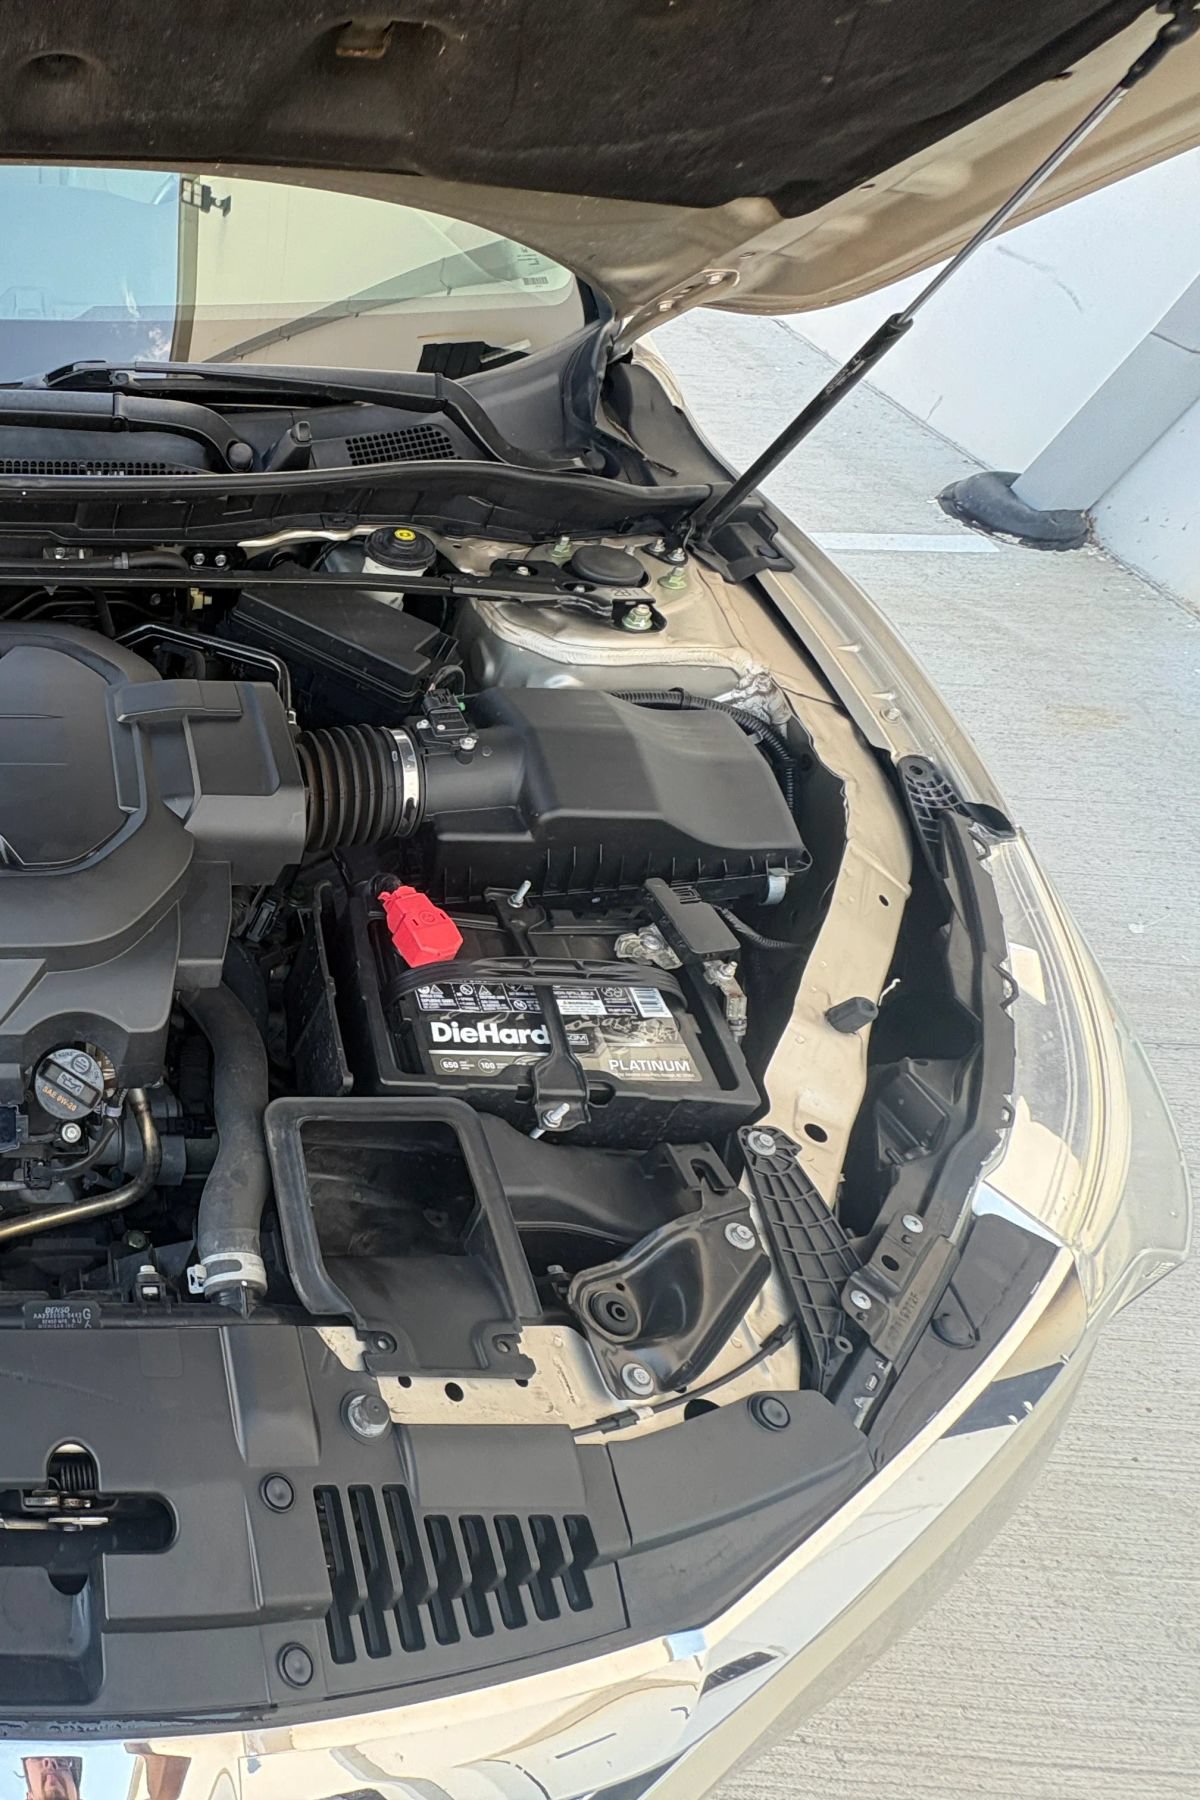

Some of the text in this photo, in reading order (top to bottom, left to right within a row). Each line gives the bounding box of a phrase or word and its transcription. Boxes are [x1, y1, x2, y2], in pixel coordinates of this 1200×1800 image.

[430, 1021, 551, 1045] DieHard
[442, 1061, 459, 1069] 650
[480, 1061, 496, 1070] 100
[608, 1059, 690, 1072] PLATINUM
